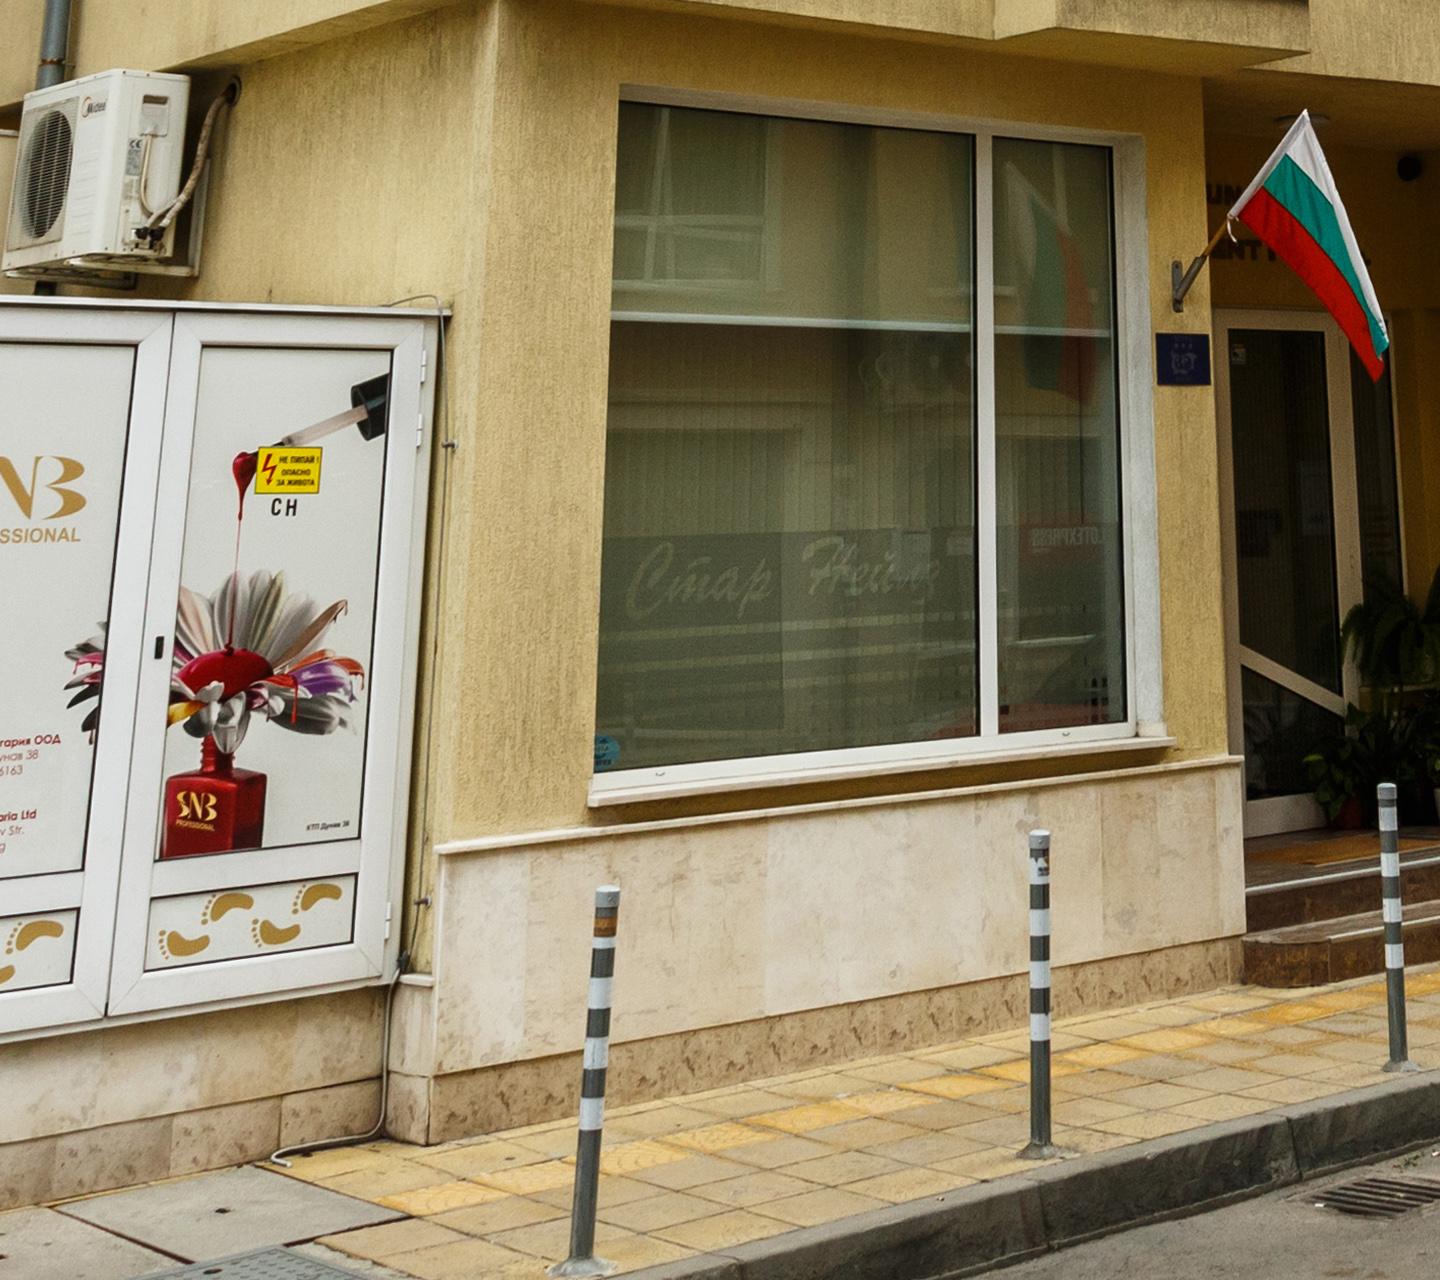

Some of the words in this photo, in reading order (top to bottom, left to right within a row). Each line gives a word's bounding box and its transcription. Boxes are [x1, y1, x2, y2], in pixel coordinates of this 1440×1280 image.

[34, 733, 62, 745] ООД
[26, 749, 39, 760] 38
[176, 791, 218, 822] SNB
[21, 809, 37, 820] Ltd
